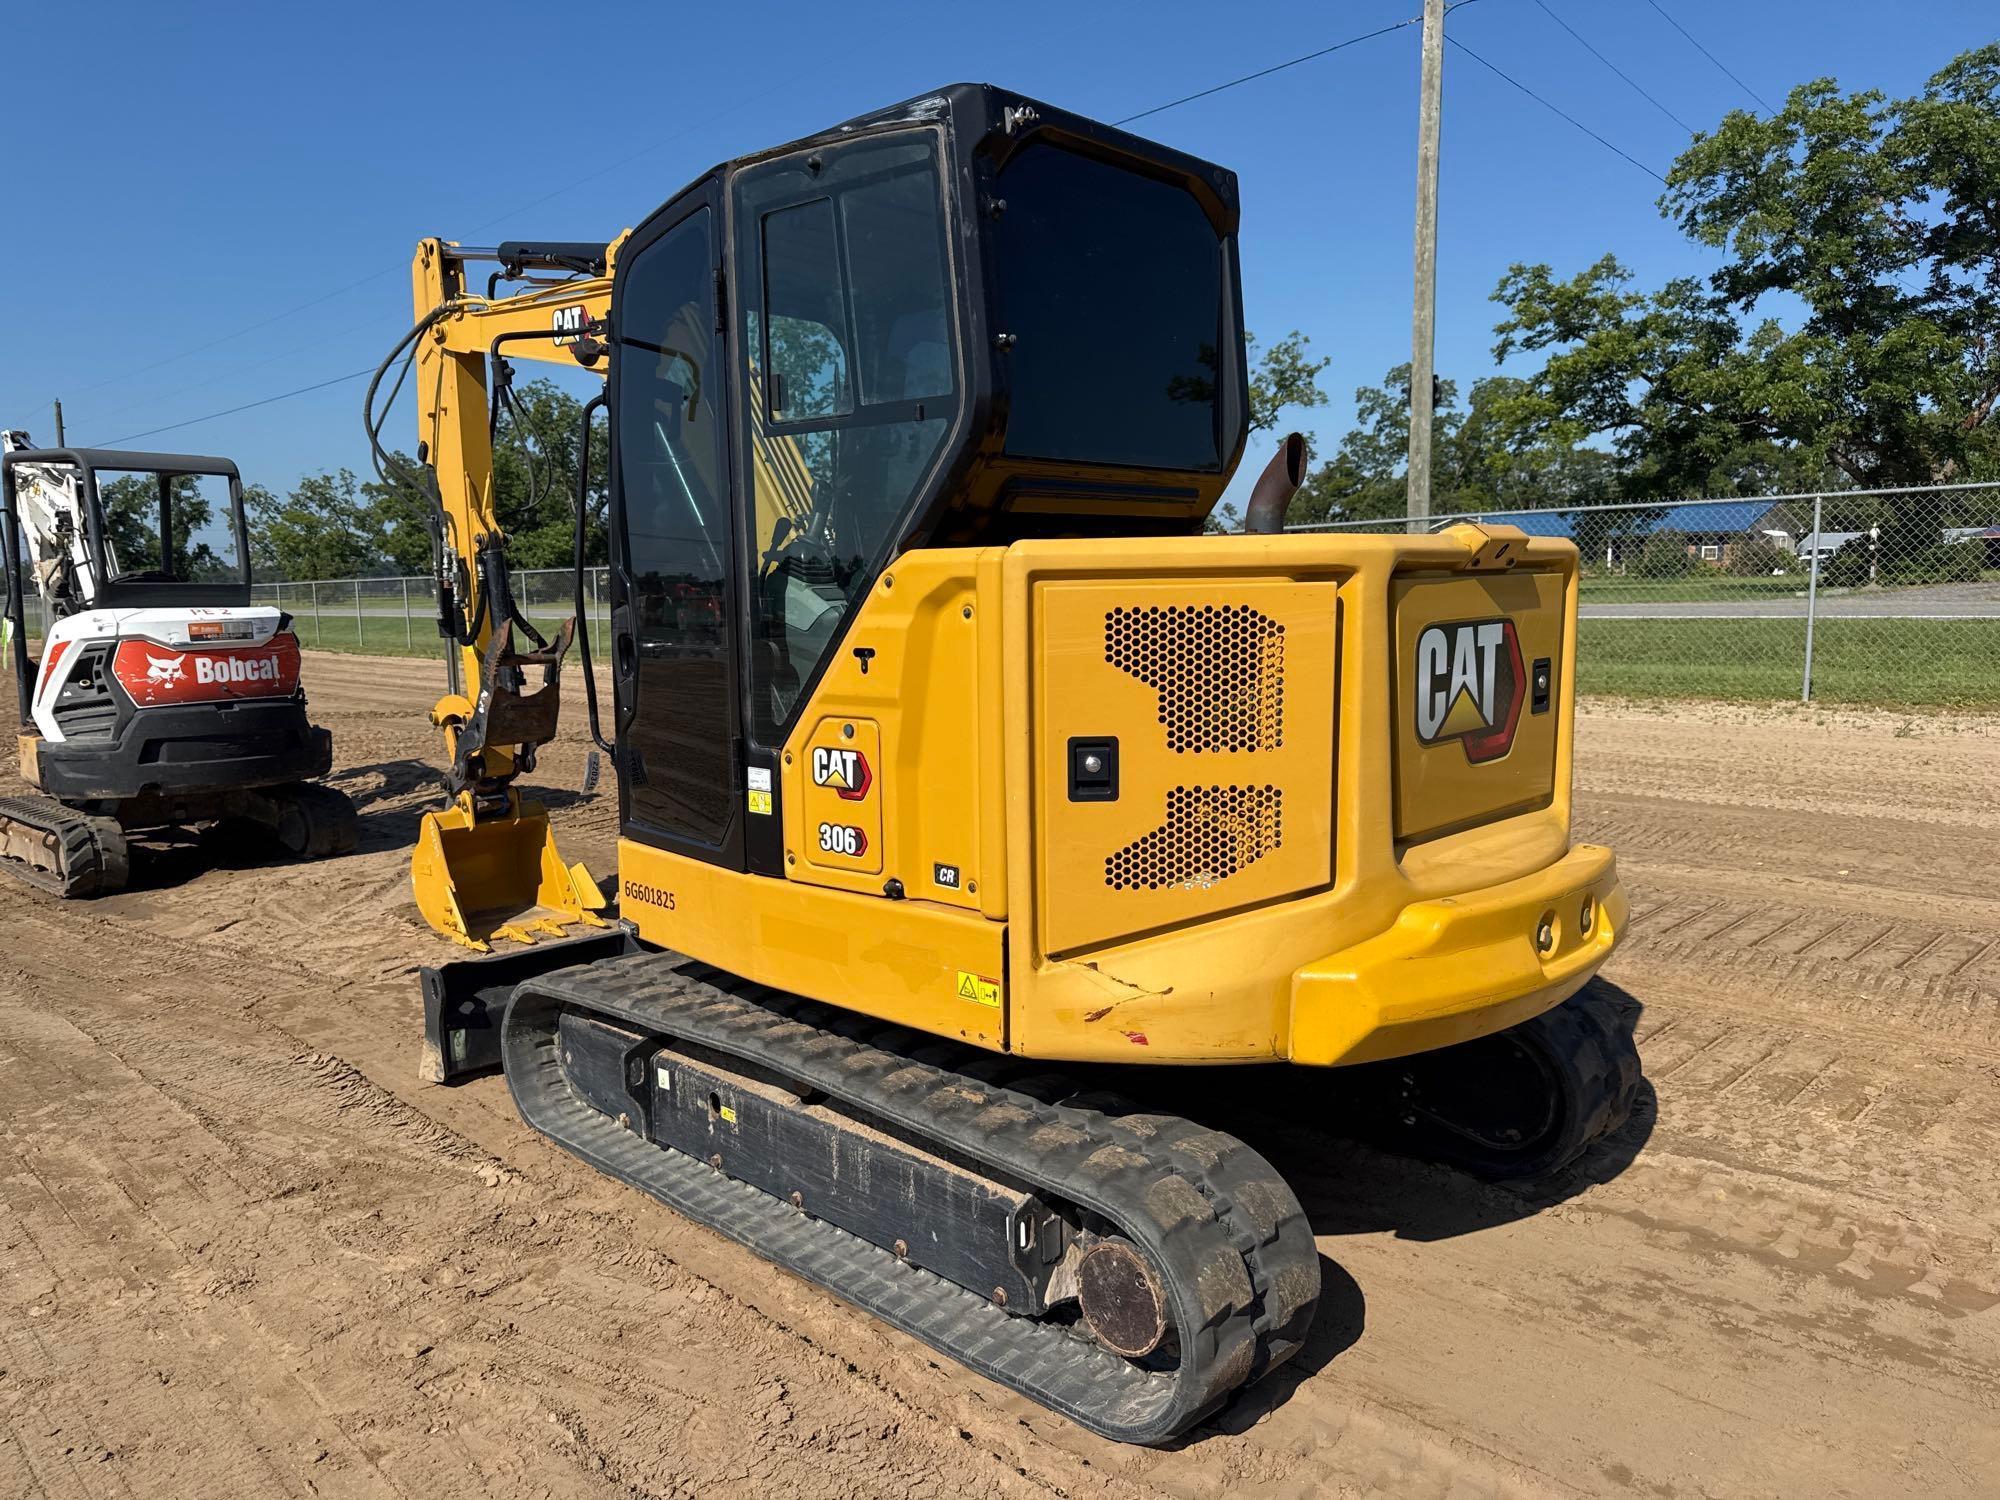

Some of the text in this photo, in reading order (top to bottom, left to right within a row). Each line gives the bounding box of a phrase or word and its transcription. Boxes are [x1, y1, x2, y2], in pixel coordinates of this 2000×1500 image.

[553, 306, 581, 346] CAT
[195, 655, 280, 684] Bobcat
[1417, 623, 1504, 740] CAT
[813, 747, 857, 789] CAT
[820, 823, 857, 855] 306
[940, 867, 955, 884] CR
[624, 880, 676, 911] 6G601825
